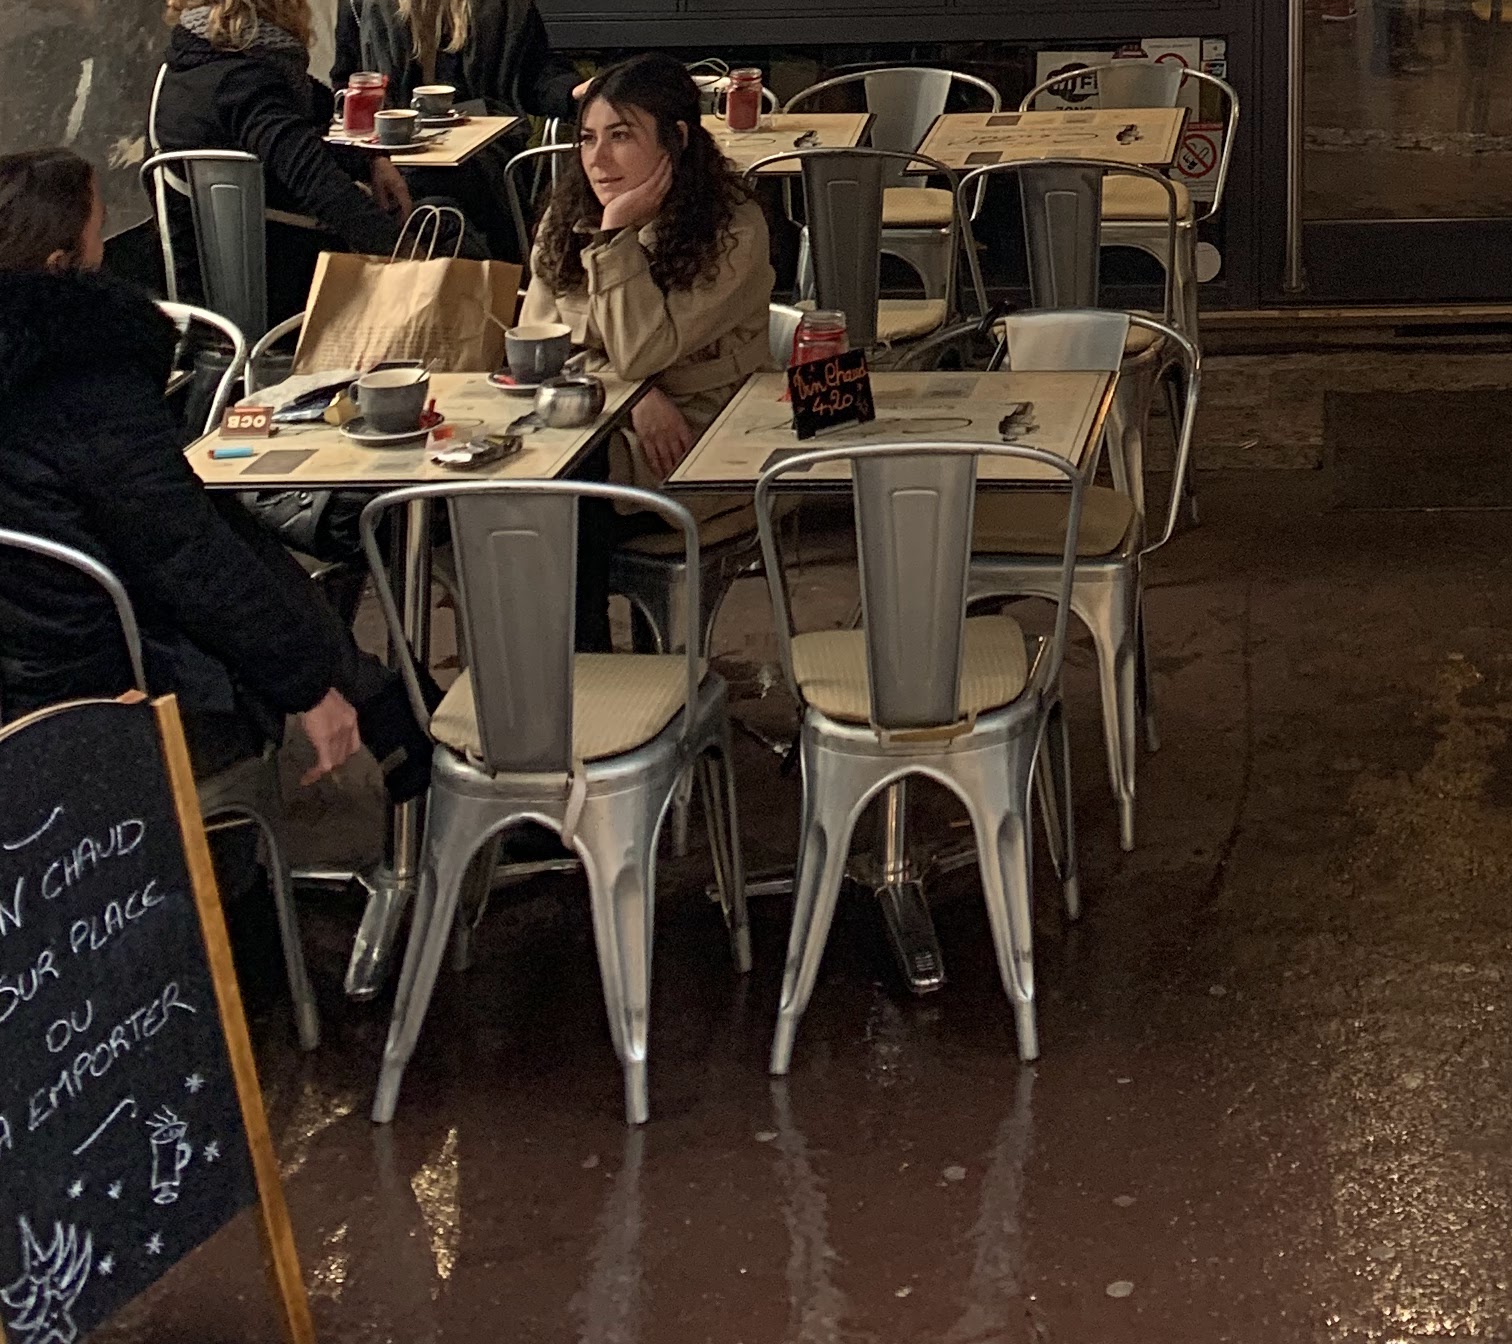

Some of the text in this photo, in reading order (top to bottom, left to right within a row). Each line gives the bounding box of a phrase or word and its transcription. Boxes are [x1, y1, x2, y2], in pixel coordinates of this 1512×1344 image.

[793, 358, 867, 400] Vin Chaud
[227, 415, 266, 429] OCB
[42, 818, 144, 900] CHAUD
[0, 879, 165, 1023] SUR PLACE
[28, 981, 196, 1132] EMPORTER
[45, 999, 93, 1053] OU
